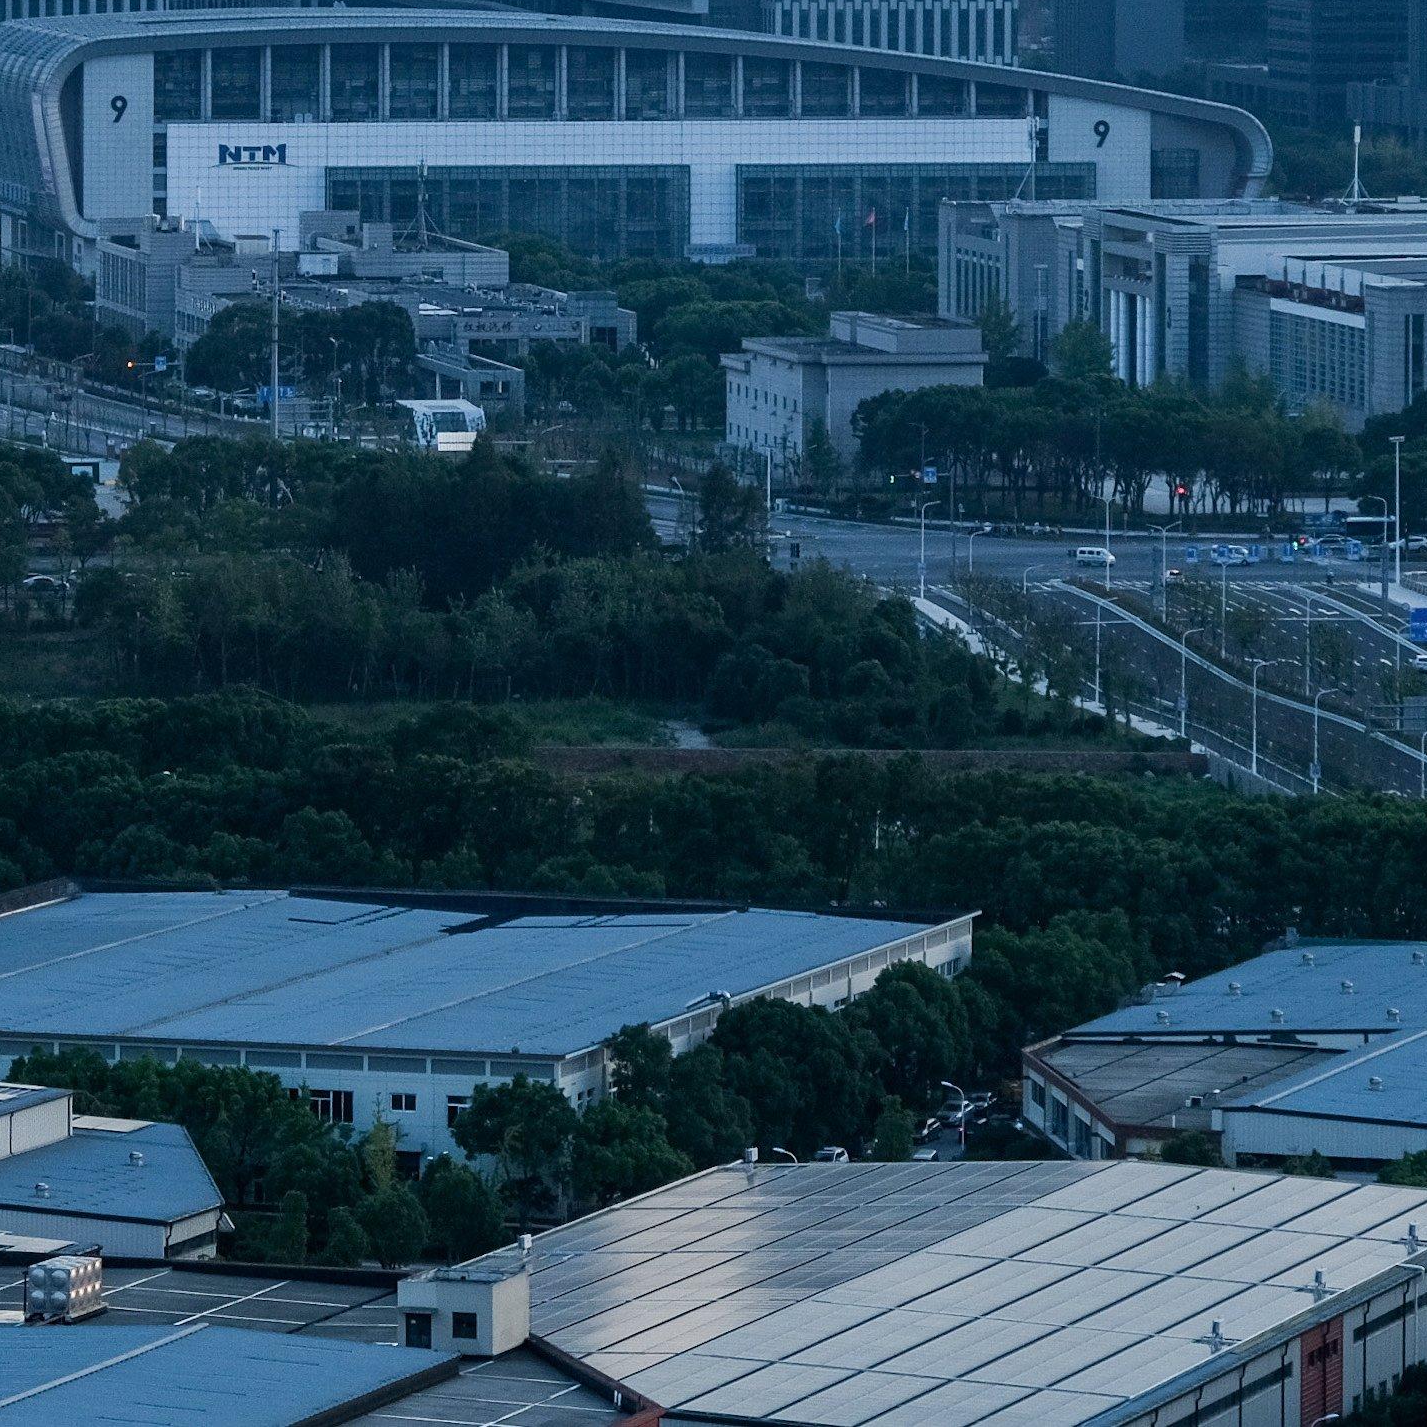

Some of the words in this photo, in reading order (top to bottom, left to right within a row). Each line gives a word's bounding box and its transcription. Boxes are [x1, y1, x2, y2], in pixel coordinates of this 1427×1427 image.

[111, 95, 128, 123] 9
[1094, 120, 1111, 148] 9
[218, 143, 287, 164] NTM
